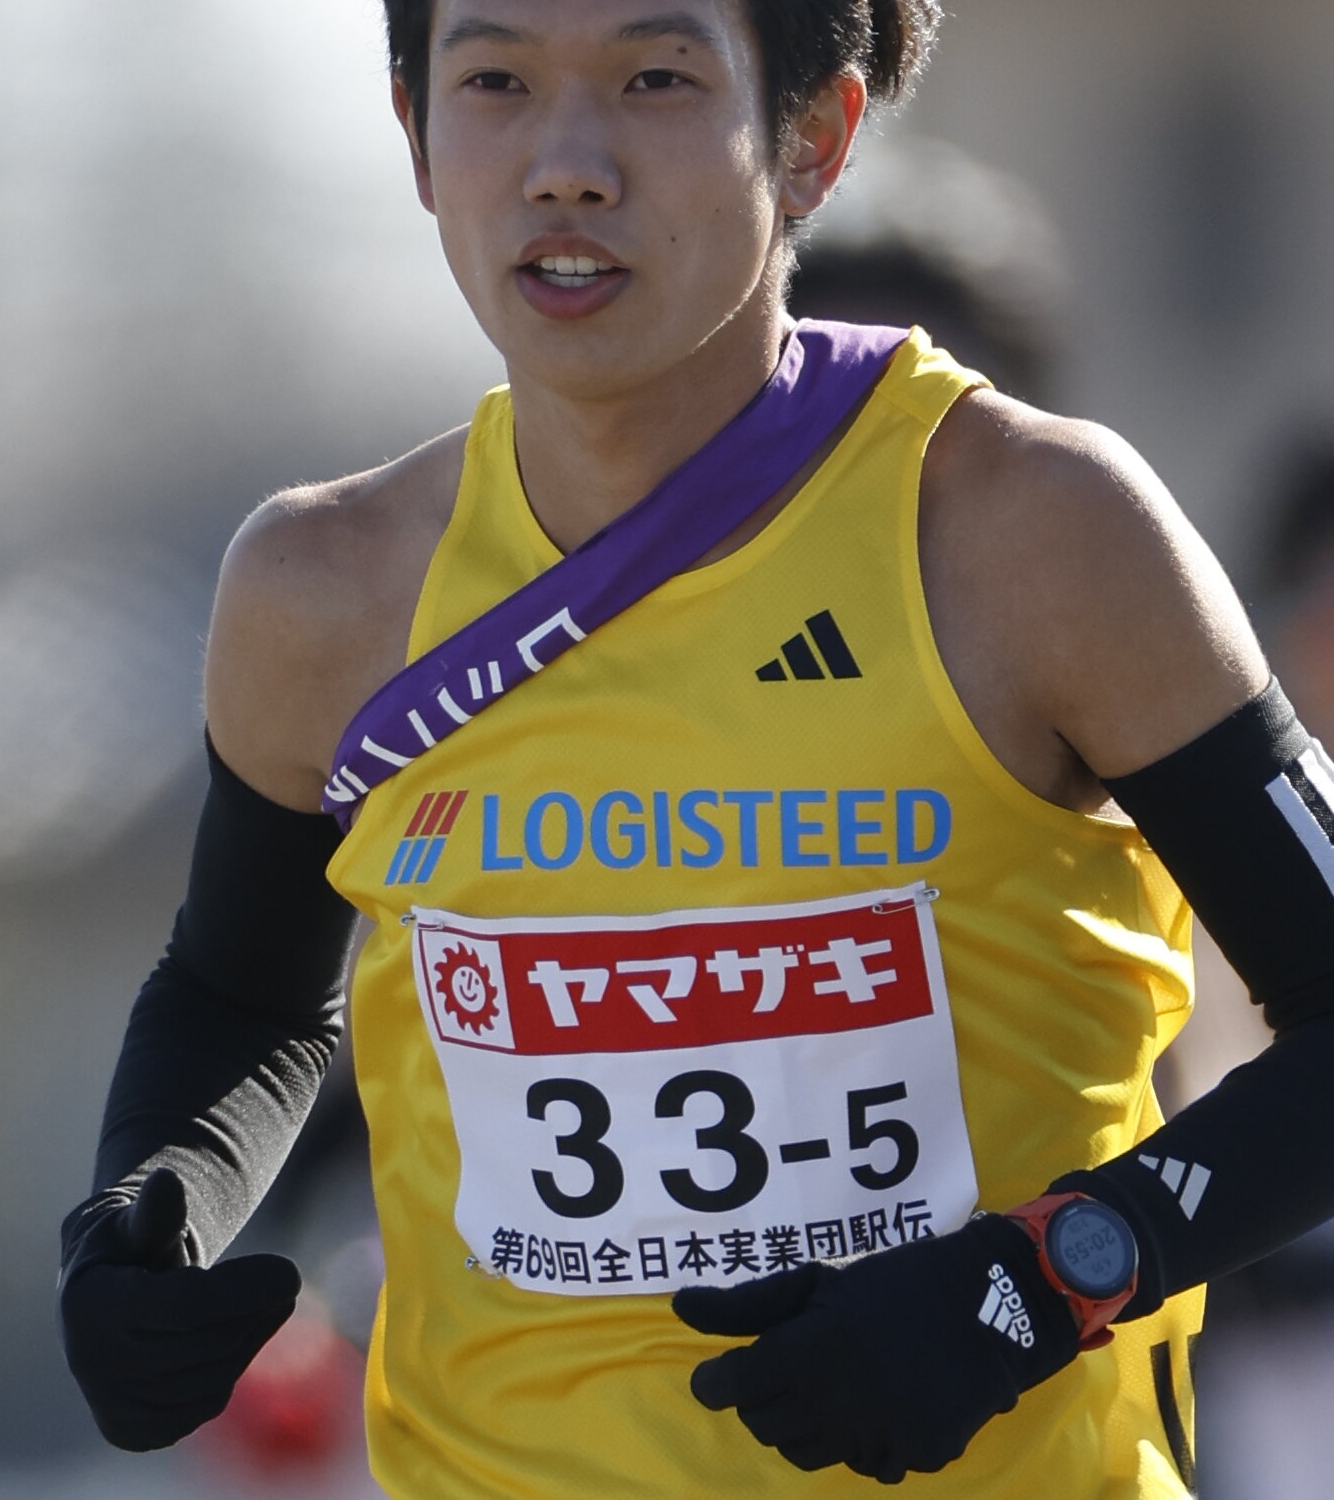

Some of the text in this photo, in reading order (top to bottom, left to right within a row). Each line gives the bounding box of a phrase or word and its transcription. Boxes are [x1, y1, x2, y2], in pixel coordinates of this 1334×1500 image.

[481, 788, 953, 871] LOGISTEED
[527, 936, 898, 1028] ヤマザキ
[526, 1069, 920, 1219] 33-5
[490, 1199, 936, 1285] 第69回全日本実業団駅伝
[988, 1263, 1035, 1349] adidas
